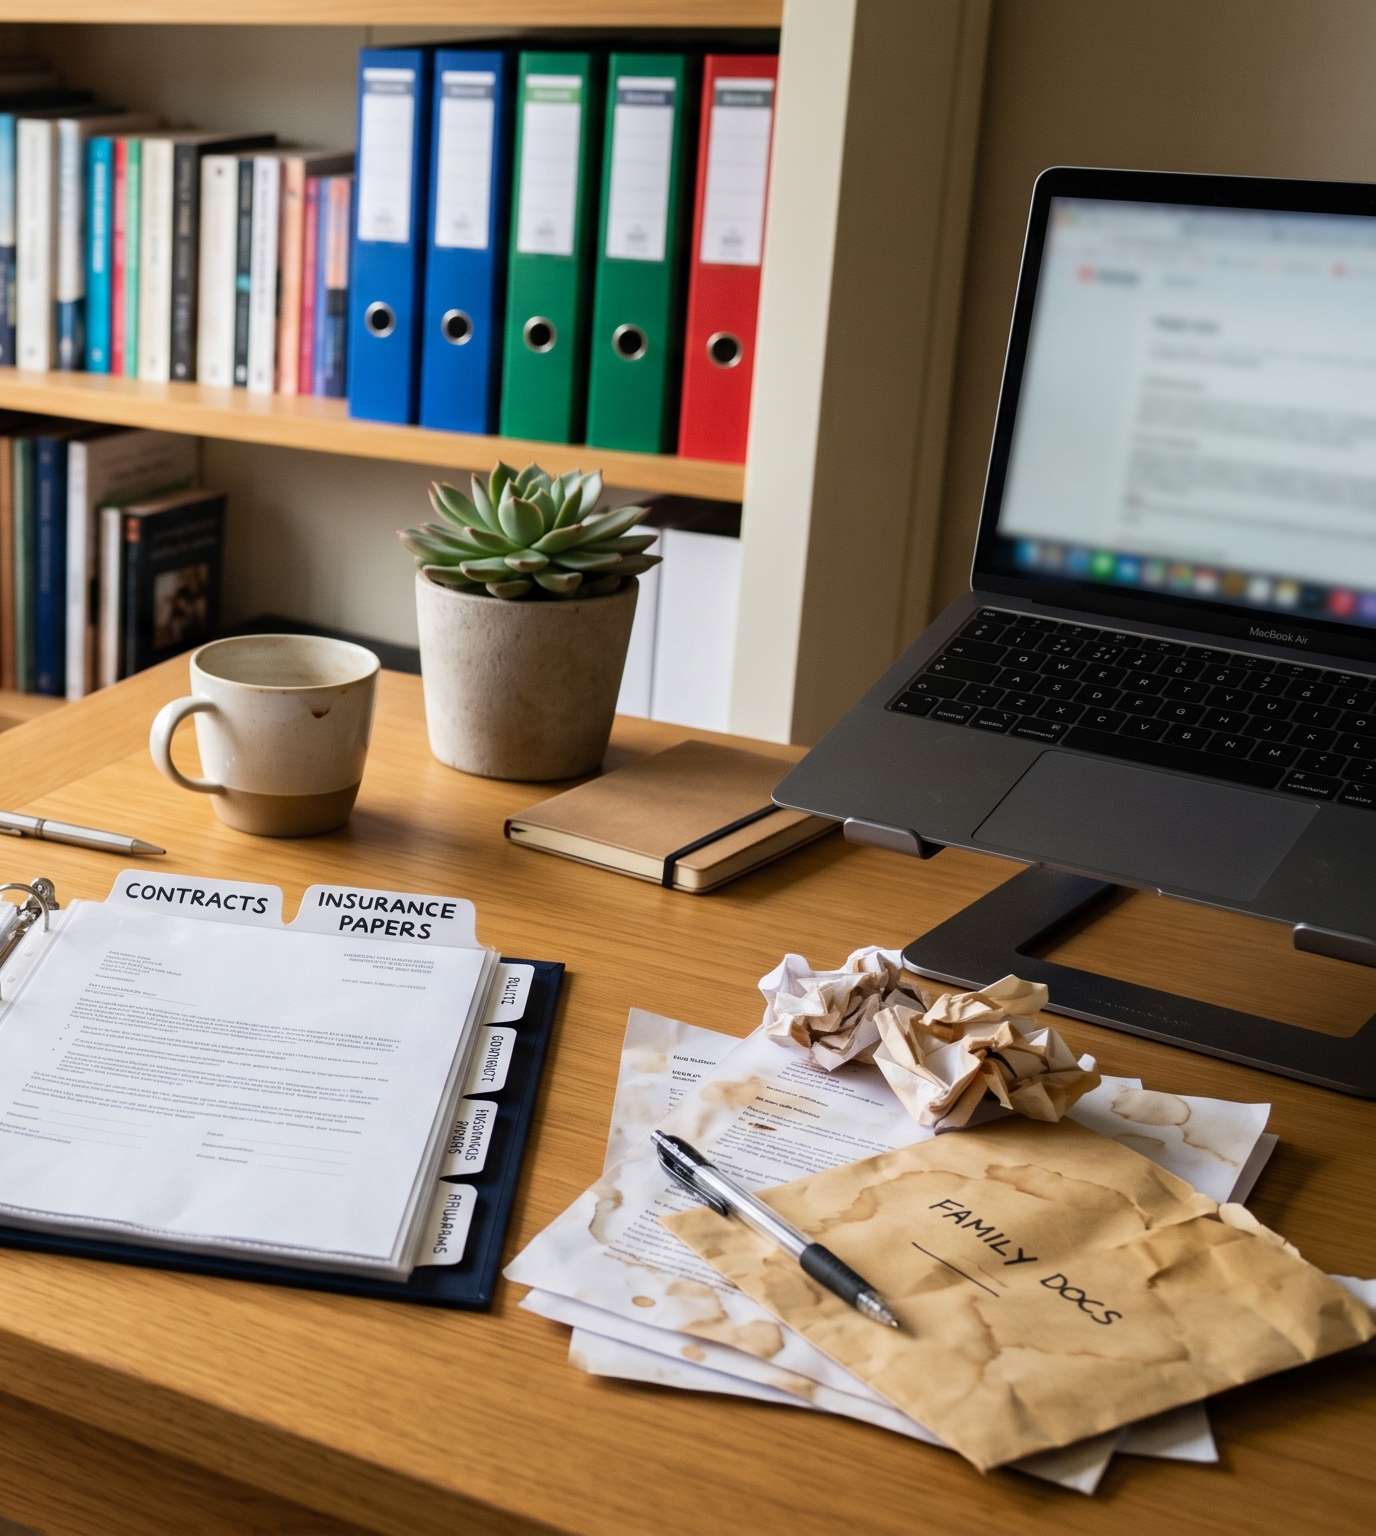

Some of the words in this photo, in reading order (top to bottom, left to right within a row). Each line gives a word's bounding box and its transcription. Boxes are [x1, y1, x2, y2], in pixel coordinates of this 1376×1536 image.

[1249, 626, 1294, 642] MacBook
[1295, 634, 1309, 644] Air
[125, 882, 269, 914] CONTRACTS
[318, 891, 458, 919] INSURANCE
[338, 914, 433, 940] PAPERS
[928, 1198, 1039, 1266] FAMILY
[1039, 1272, 1124, 1326] DOCS
